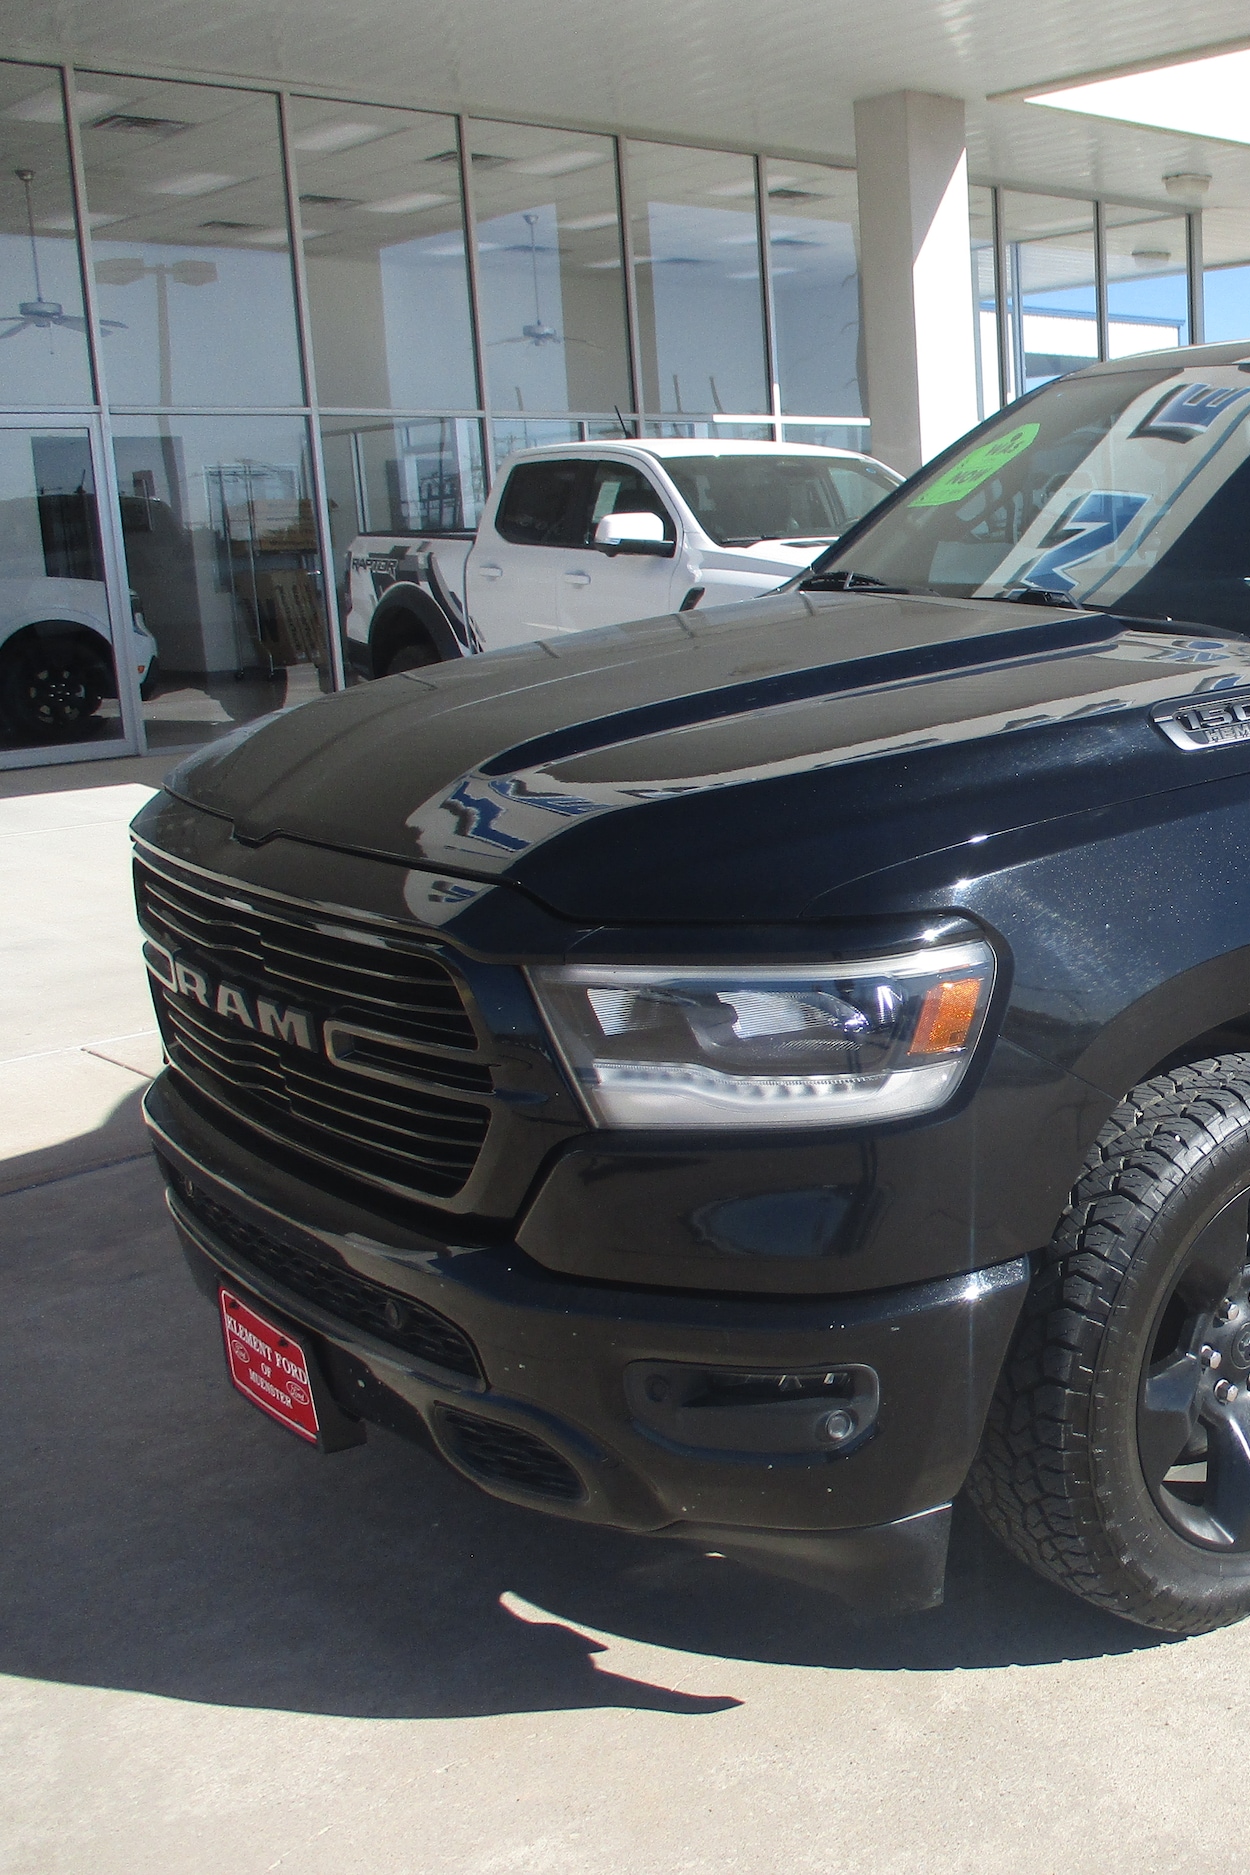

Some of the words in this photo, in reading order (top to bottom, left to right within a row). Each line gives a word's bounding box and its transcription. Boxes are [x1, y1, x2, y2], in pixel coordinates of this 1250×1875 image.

[352, 558, 399, 580] RAPTOR
[174, 957, 317, 1053] RAM
[226, 1314, 273, 1362] KLEMENT
[274, 1351, 308, 1385] FORD
[248, 1368, 293, 1409] MUENSTER
[260, 1362, 272, 1379] OF
